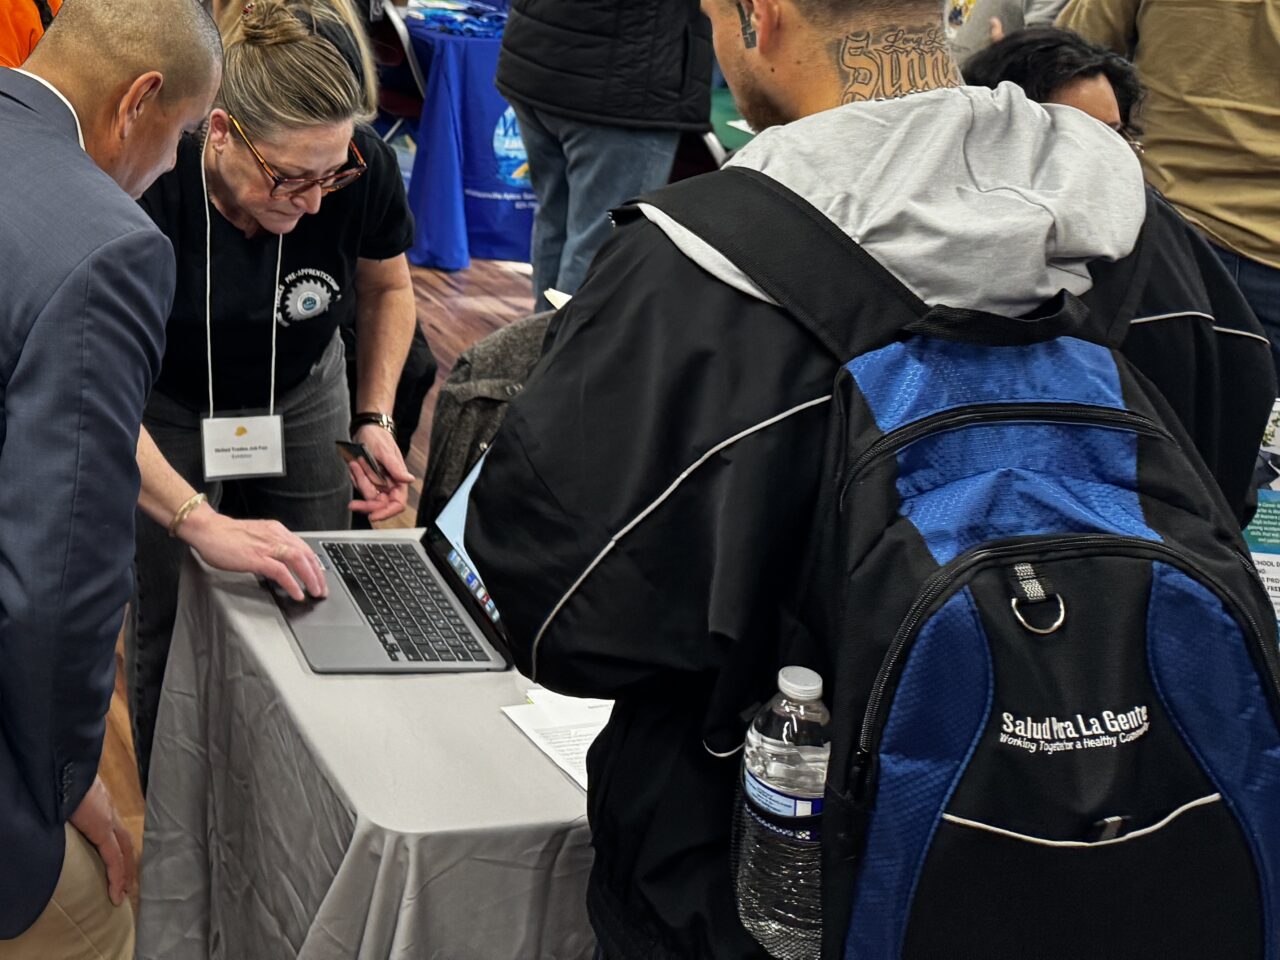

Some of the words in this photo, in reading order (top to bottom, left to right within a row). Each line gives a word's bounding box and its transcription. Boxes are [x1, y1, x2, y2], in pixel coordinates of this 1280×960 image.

[1255, 560, 1275, 568] CHOOL
[1002, 712, 1051, 739] Salud
[1076, 714, 1105, 736] La
[1102, 705, 1148, 732] Gente
[1000, 733, 1037, 753] Working
[1083, 734, 1118, 748] Healthy
